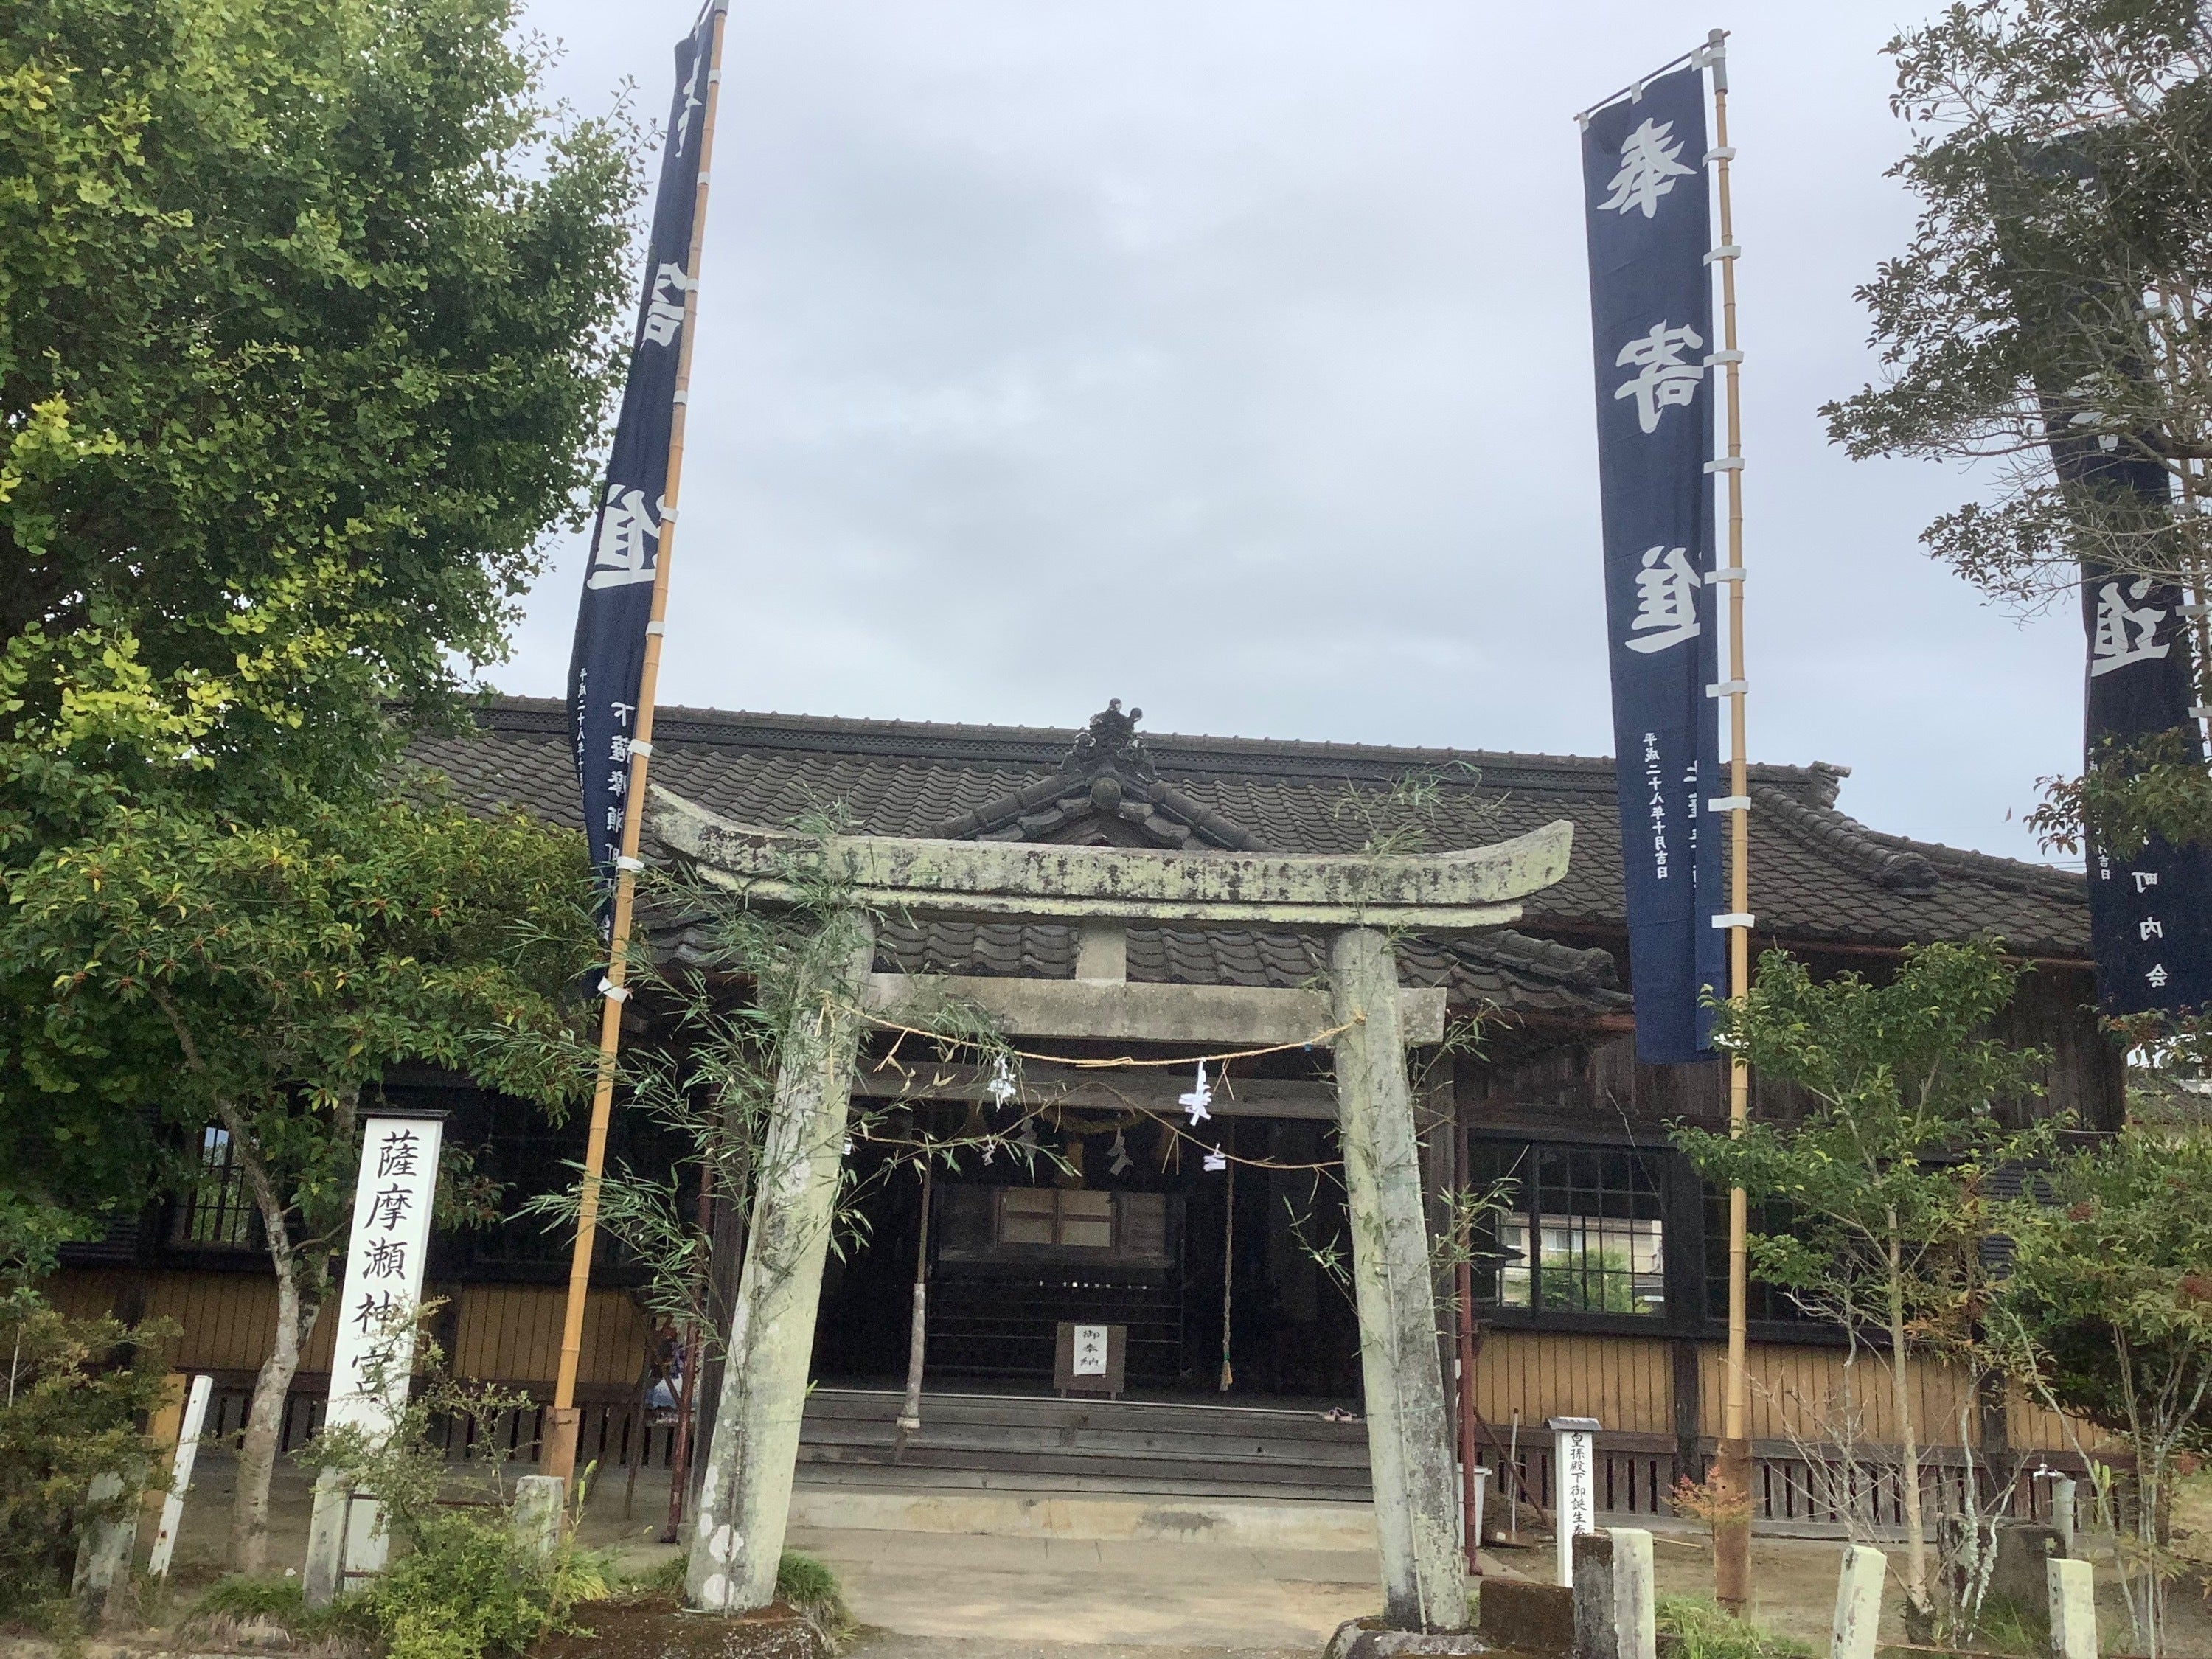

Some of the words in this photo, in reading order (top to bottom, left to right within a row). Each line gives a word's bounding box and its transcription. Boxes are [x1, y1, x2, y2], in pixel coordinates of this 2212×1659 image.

[352, 1129, 420, 1402] 薩摩瀬神宮
